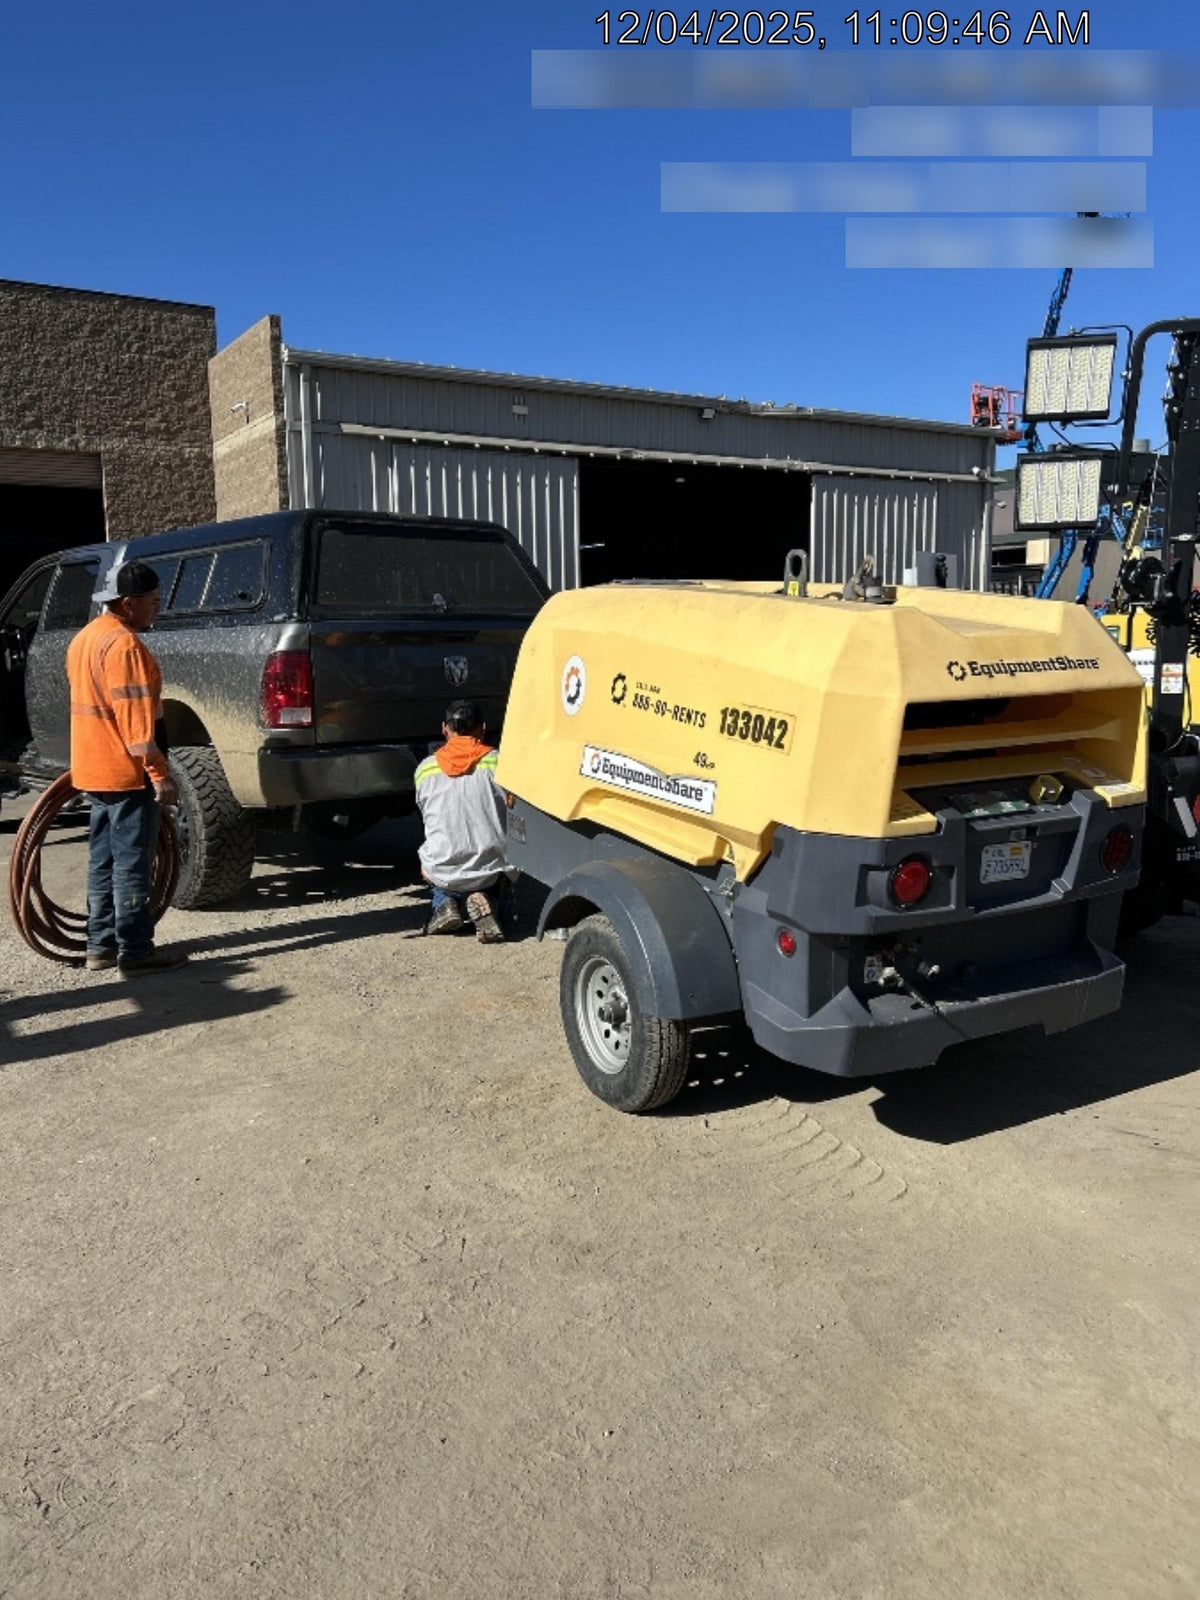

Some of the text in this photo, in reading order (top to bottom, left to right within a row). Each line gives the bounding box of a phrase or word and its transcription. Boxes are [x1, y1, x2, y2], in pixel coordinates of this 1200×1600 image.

[967, 656, 1100, 678] EquipmentShare
[719, 706, 789, 750] 133042
[602, 757, 704, 802] EquipmentShare
